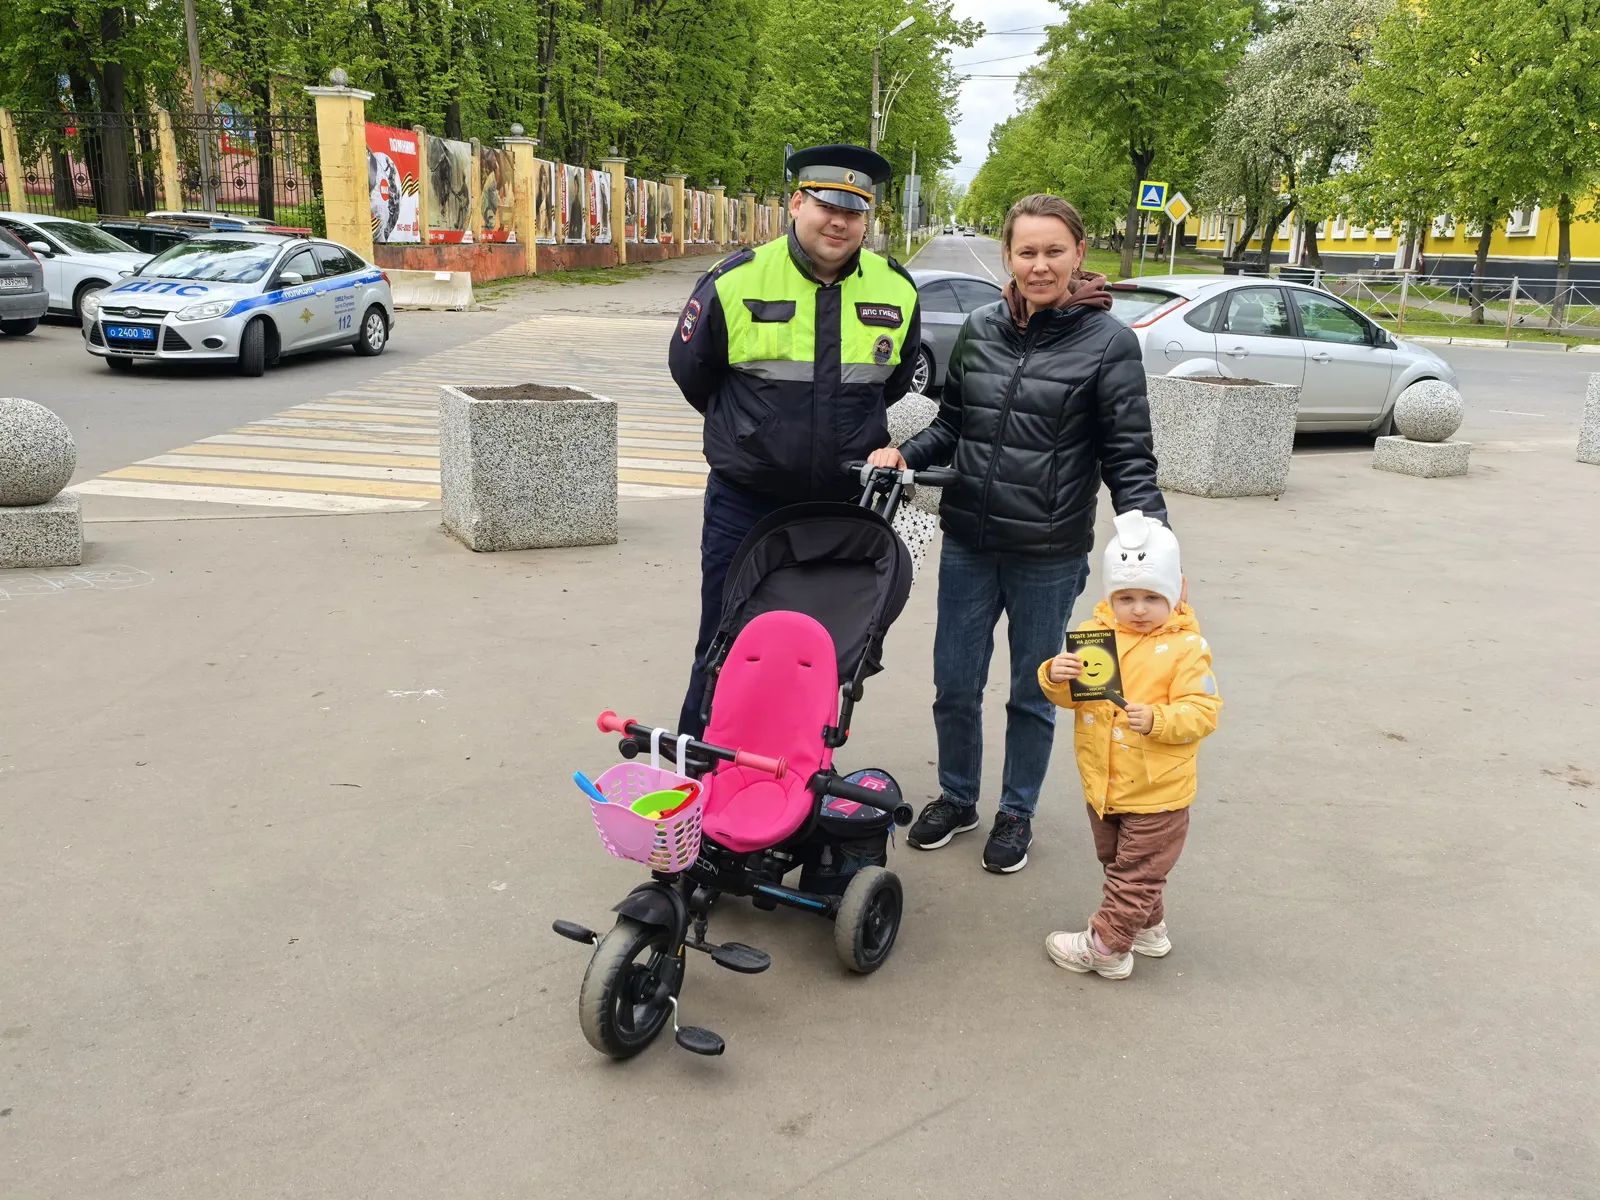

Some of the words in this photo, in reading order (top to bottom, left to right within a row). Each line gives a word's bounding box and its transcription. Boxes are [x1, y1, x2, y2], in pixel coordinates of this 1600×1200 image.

[110, 281, 208, 297] ДПС
[284, 286, 315, 299] ПОЛИЦИЯ
[862, 308, 878, 316] ДПС
[879, 309, 899, 320] ГИБДД
[338, 315, 352, 330] 112
[118, 328, 138, 337] 2400
[142, 328, 151, 336] 50
